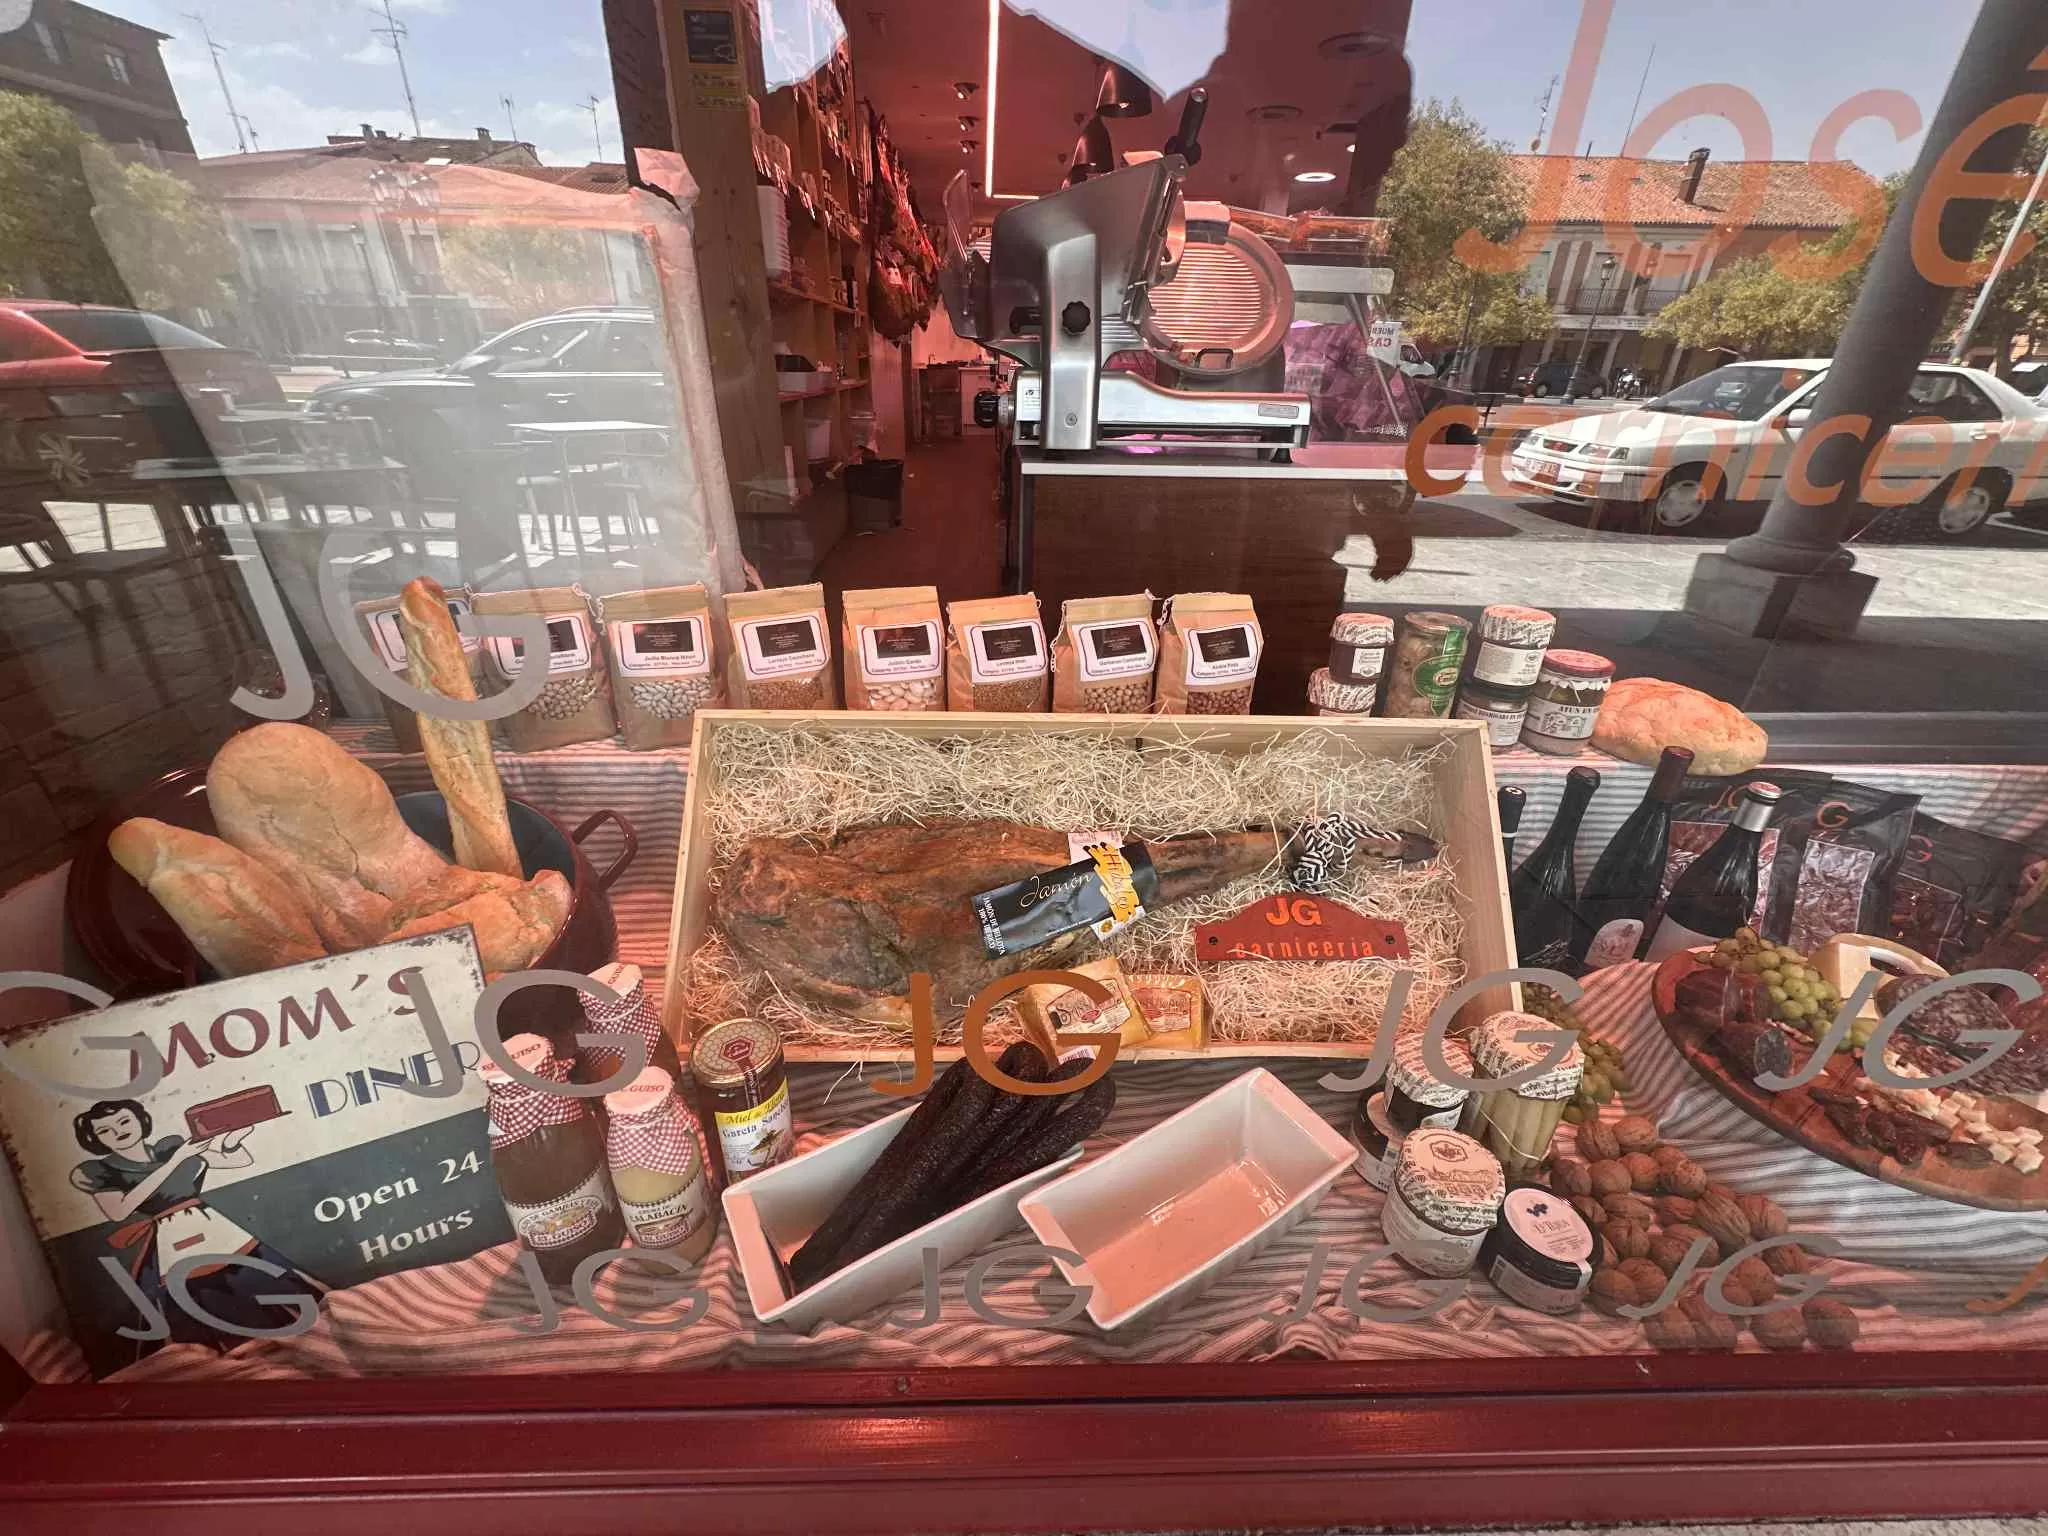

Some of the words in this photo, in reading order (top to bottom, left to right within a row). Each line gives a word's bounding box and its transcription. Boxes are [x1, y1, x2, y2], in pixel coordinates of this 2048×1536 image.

[224, 525, 550, 719] JG
[1020, 872, 1094, 908] Jamón
[1266, 896, 1322, 928] JG
[398, 968, 647, 1098] JG
[511, 1043, 542, 1060] UISO
[871, 970, 1121, 1097] JG
[1318, 969, 1586, 1093] JG
[1754, 968, 2043, 1090] JG
[305, 1041, 483, 1119] DINER
[314, 1174, 419, 1225] Open
[438, 1151, 483, 1186] 24
[359, 1208, 474, 1265] Hours
[1616, 1233, 1843, 1320] JG
[98, 1254, 320, 1340] JG
[511, 1246, 710, 1335] JG
[890, 1245, 1094, 1328] JG
[1257, 1242, 1476, 1323] JG
